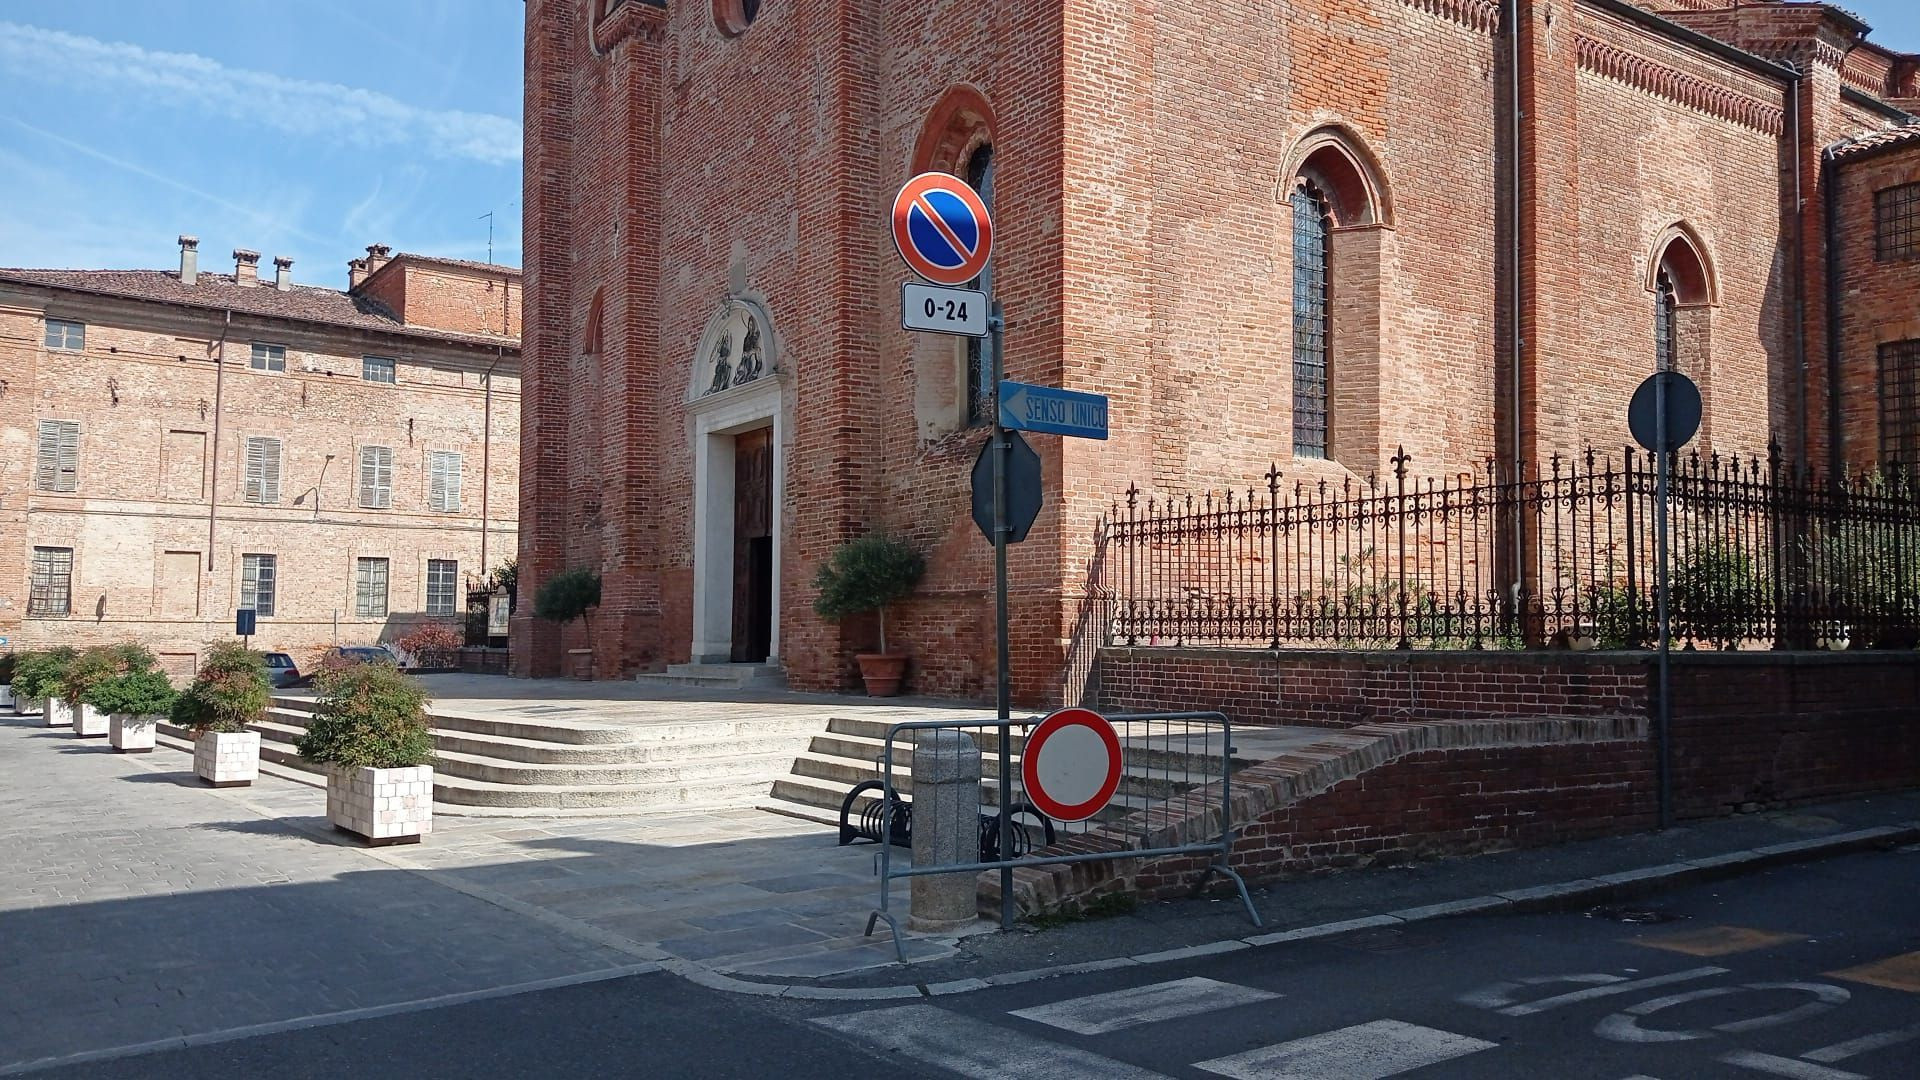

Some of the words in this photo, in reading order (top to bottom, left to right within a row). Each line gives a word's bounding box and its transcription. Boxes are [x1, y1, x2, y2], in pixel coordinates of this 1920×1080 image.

[924, 297, 968, 322] 0-24
[1026, 396, 1065, 423] SENSO
[1071, 401, 1105, 428] UNICO
